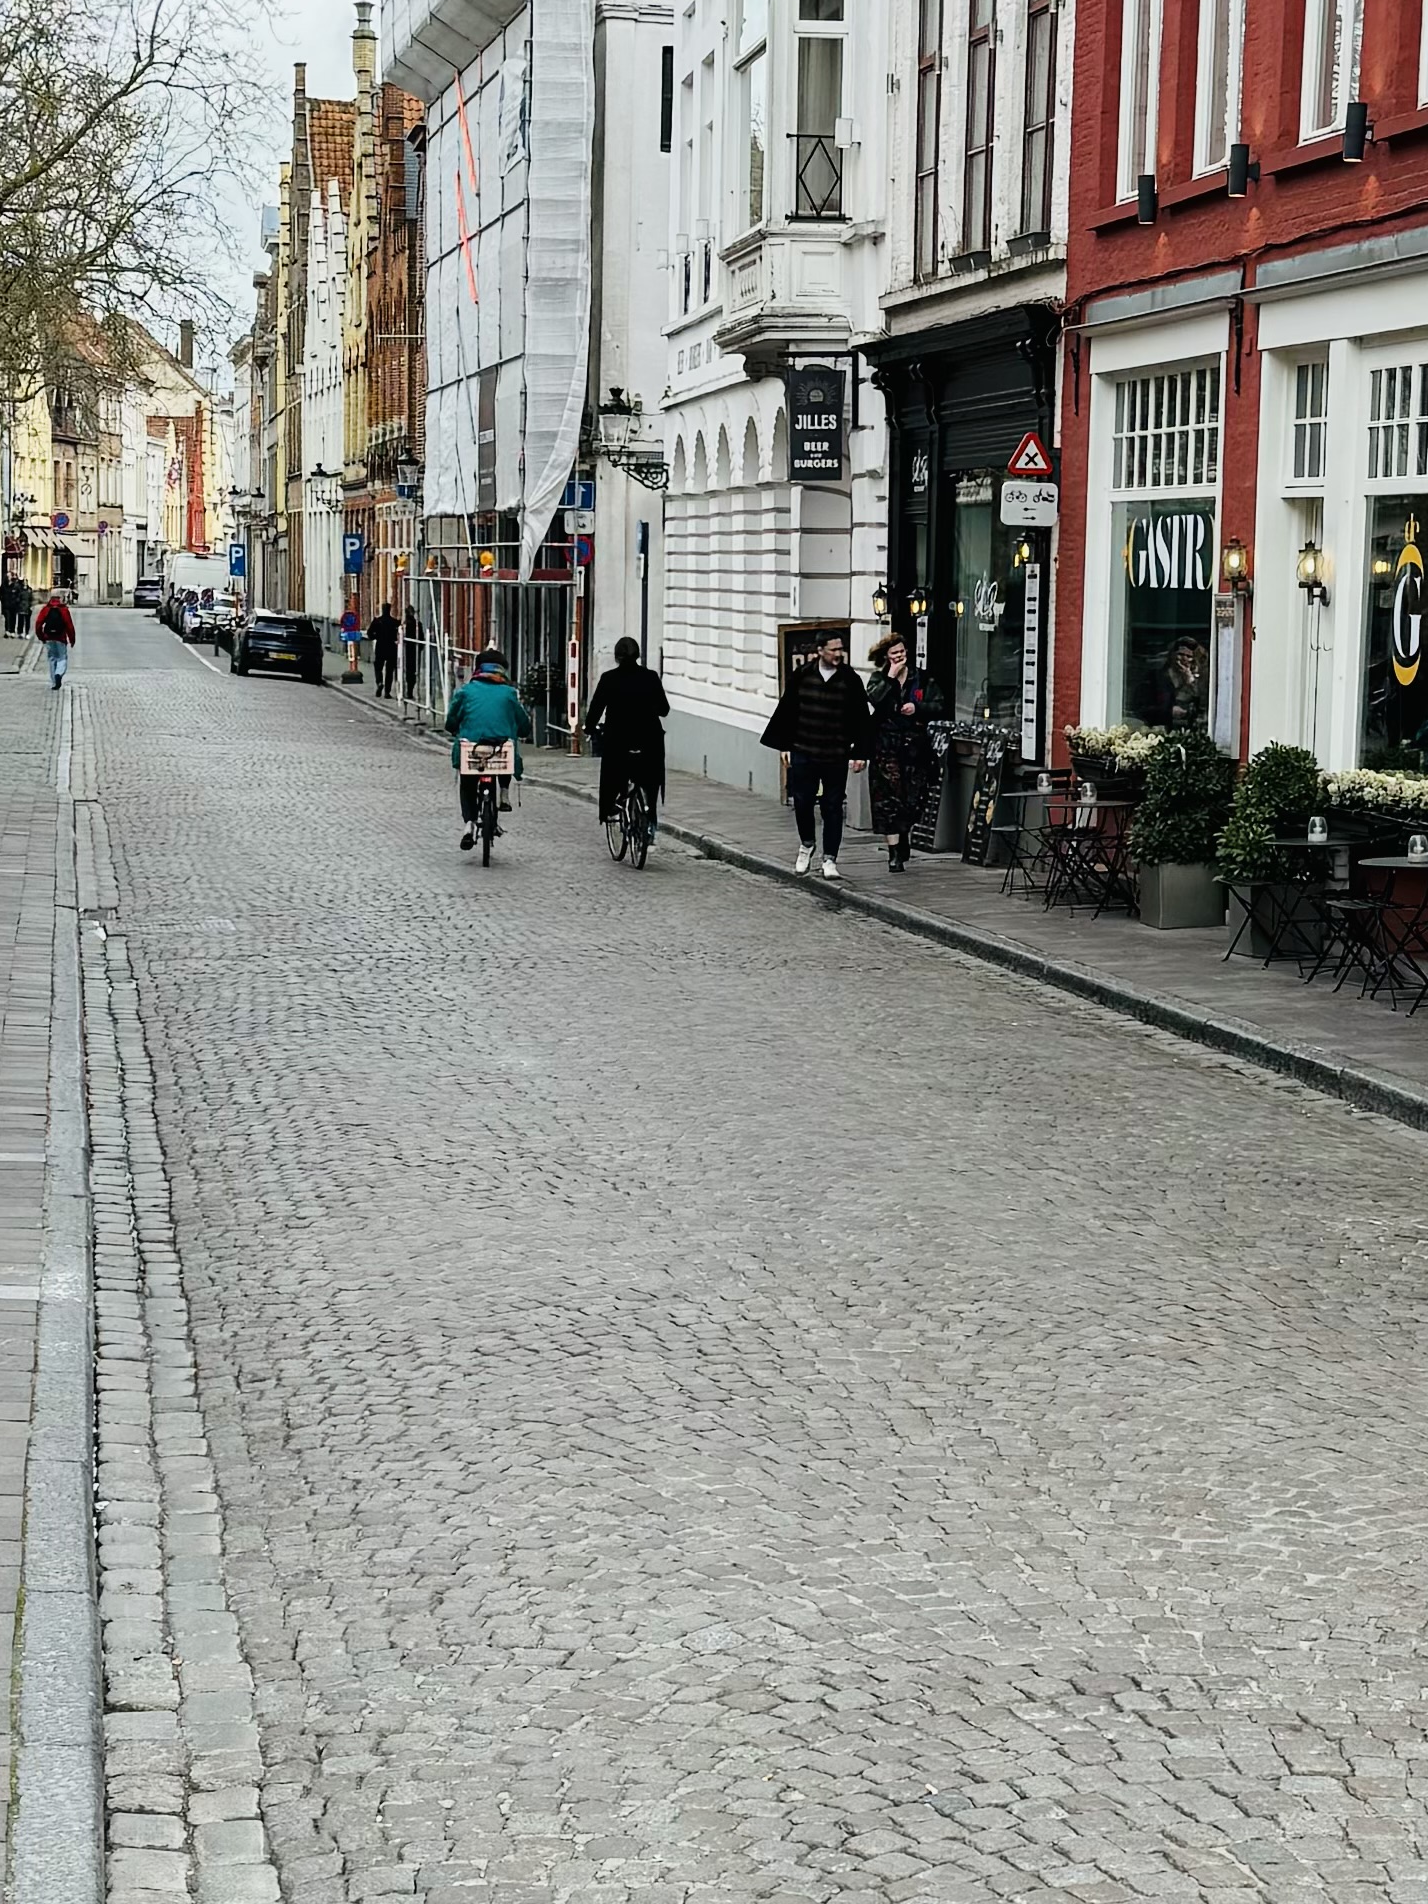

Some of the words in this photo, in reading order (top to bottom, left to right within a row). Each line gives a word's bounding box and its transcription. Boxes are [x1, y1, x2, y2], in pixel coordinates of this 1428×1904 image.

[794, 414, 838, 430] JILLES
[803, 441, 830, 452] BEER
[793, 458, 839, 469] BURGERS
[231, 546, 244, 565] P
[344, 537, 360, 559] P
